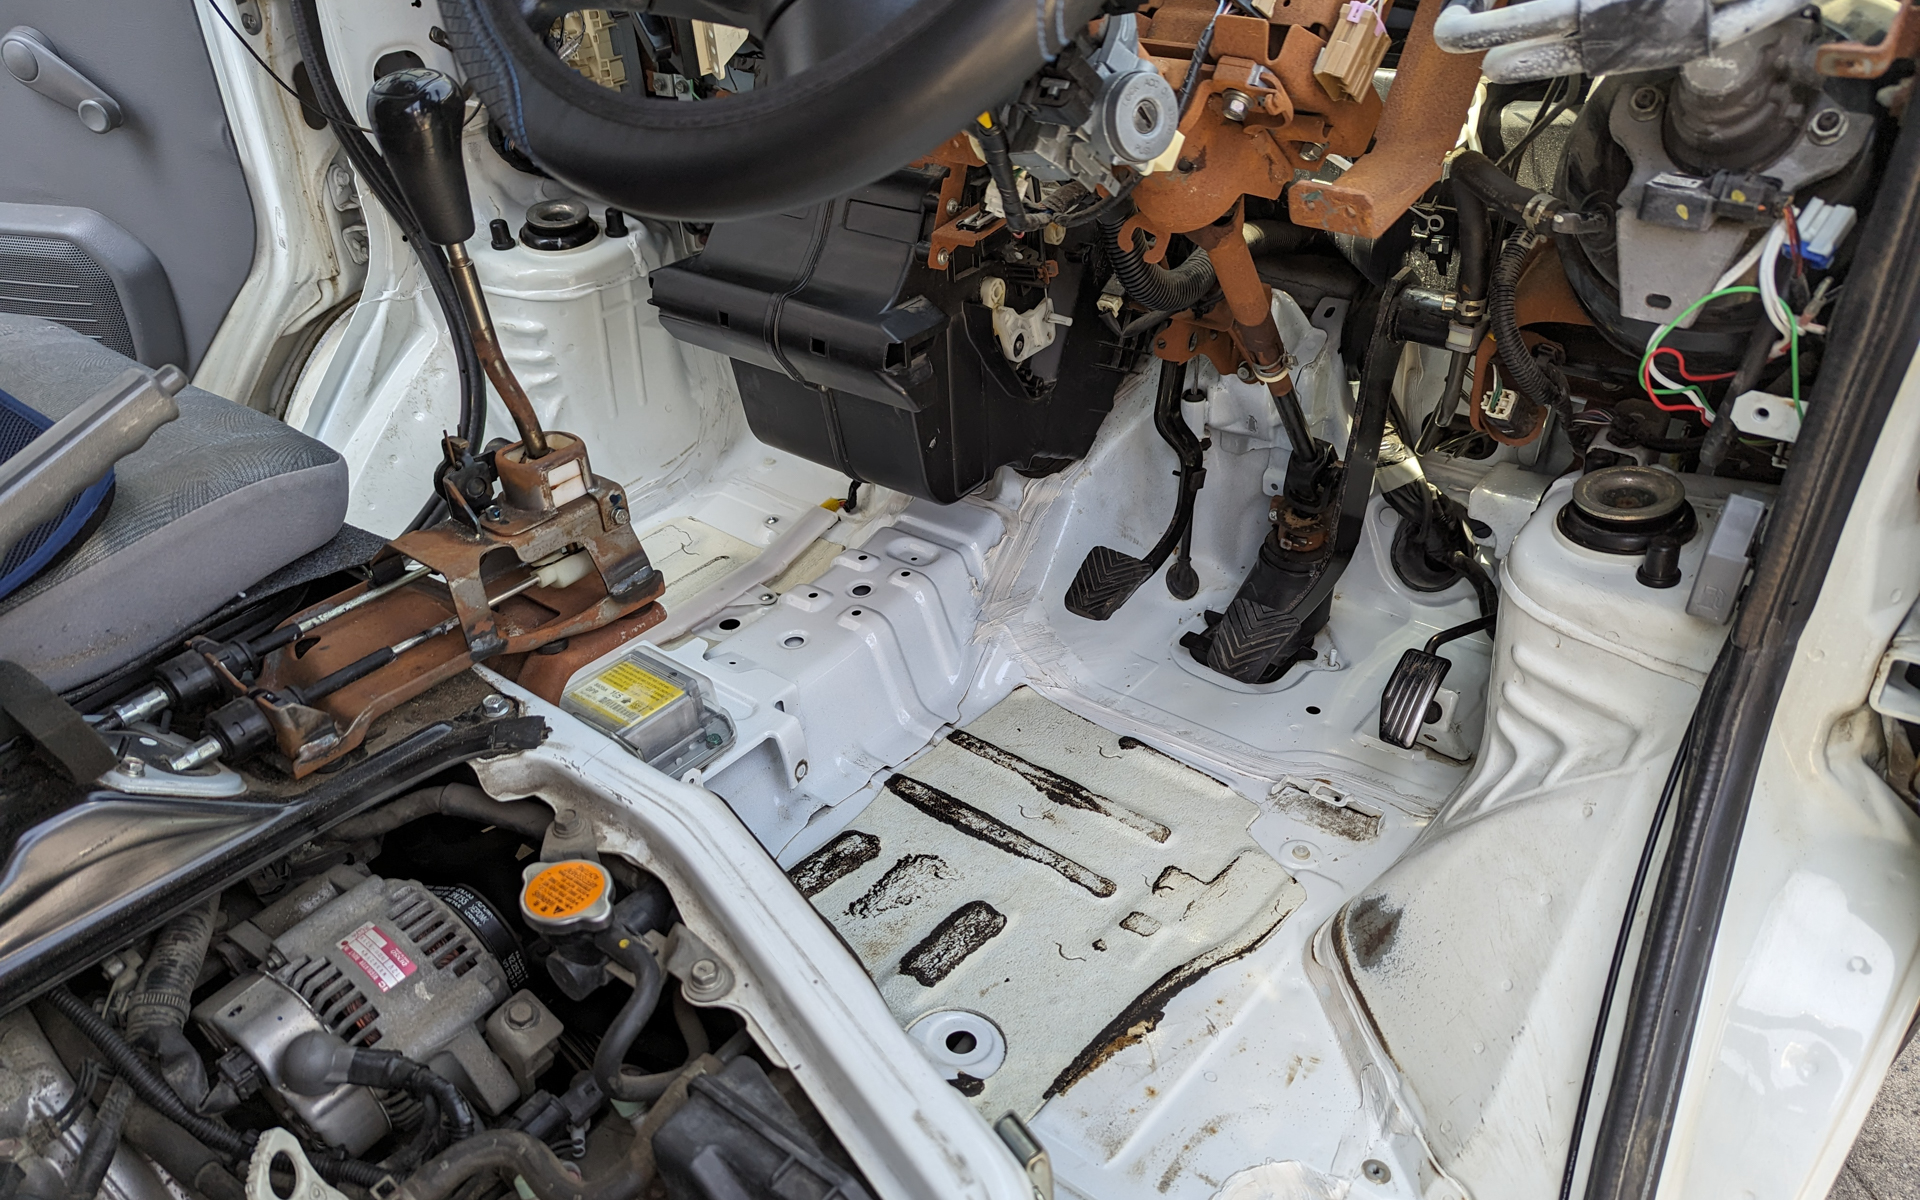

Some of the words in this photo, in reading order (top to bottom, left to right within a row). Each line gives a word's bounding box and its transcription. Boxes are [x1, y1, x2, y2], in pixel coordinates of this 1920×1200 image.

[1122, 86, 1139, 106] LOCK
[1144, 78, 1160, 89] ACC
[390, 949, 408, 967] DENSO
[377, 980, 389, 993] IC
